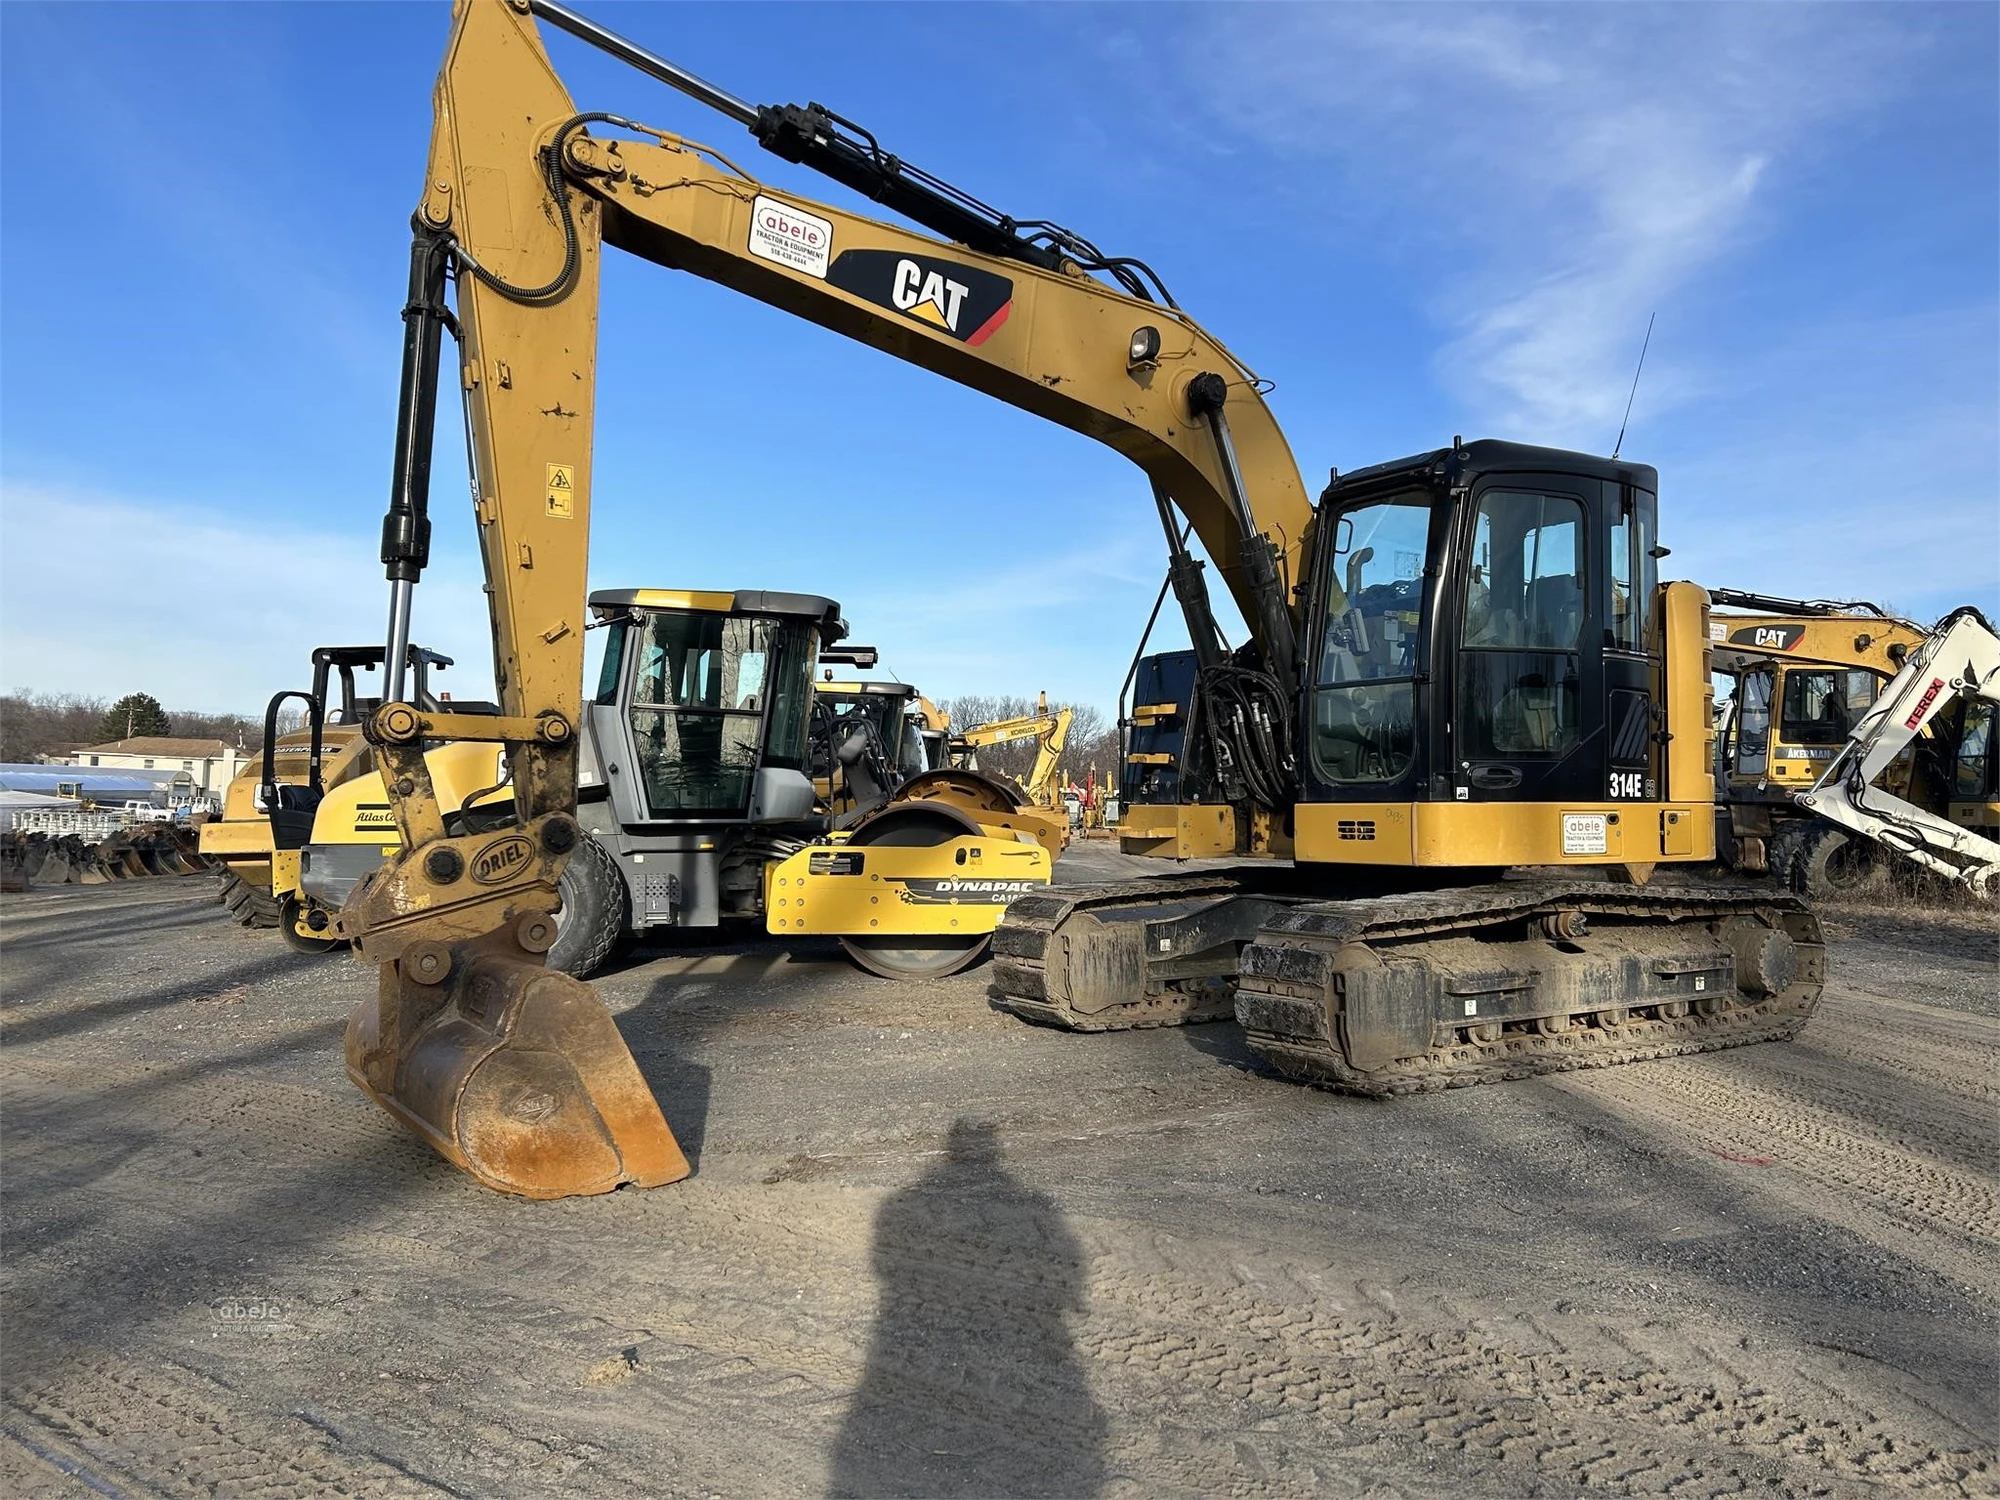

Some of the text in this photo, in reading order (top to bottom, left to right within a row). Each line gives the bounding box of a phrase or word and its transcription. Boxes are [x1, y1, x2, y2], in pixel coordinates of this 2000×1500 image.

[766, 217, 818, 244] abele
[756, 229, 784, 246] TRACTOR
[789, 242, 824, 260] EQUIPMENT
[892, 258, 969, 332] CAT
[1755, 627, 1787, 649] CAT
[1905, 681, 1944, 726] TEREX
[1609, 772, 1642, 798] 314E
[355, 812, 384, 822] Atlas
[1570, 820, 1600, 832] abele
[480, 842, 524, 877] ORIEL
[935, 881, 1034, 892] DYNAPAC
